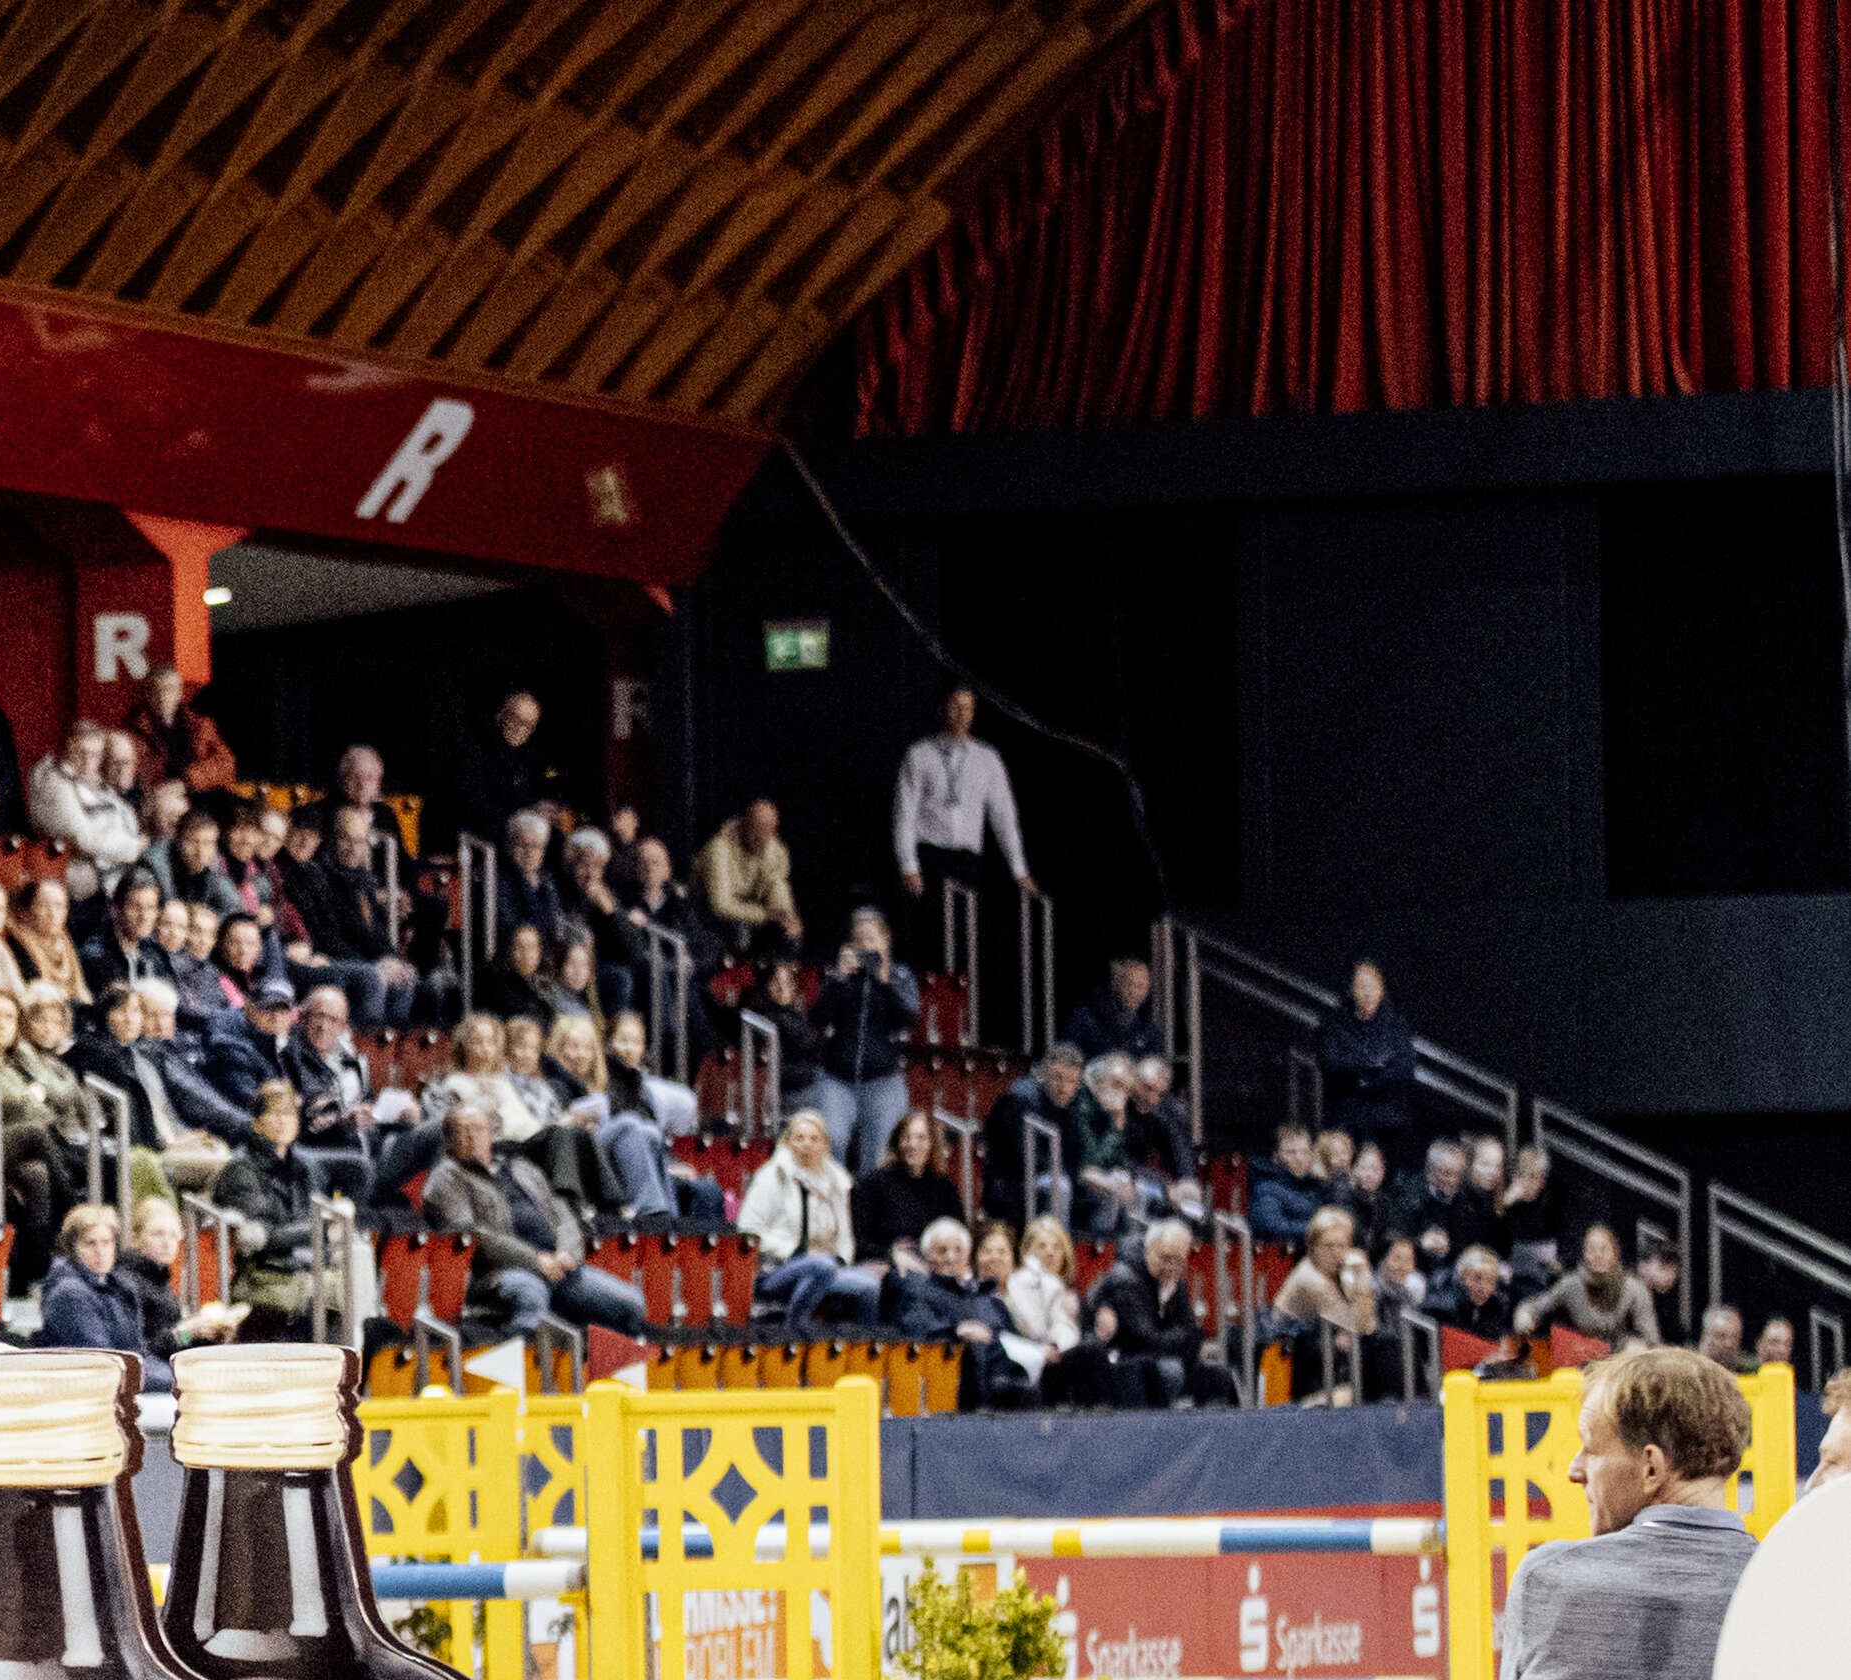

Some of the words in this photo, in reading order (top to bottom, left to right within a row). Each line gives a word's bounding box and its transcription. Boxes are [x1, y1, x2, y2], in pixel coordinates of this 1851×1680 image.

[354, 399, 474, 523] R
[94, 613, 152, 682] R
[1085, 1625, 1182, 1680] Sparkasse
[1275, 1611, 1363, 1680] Sparkasse
